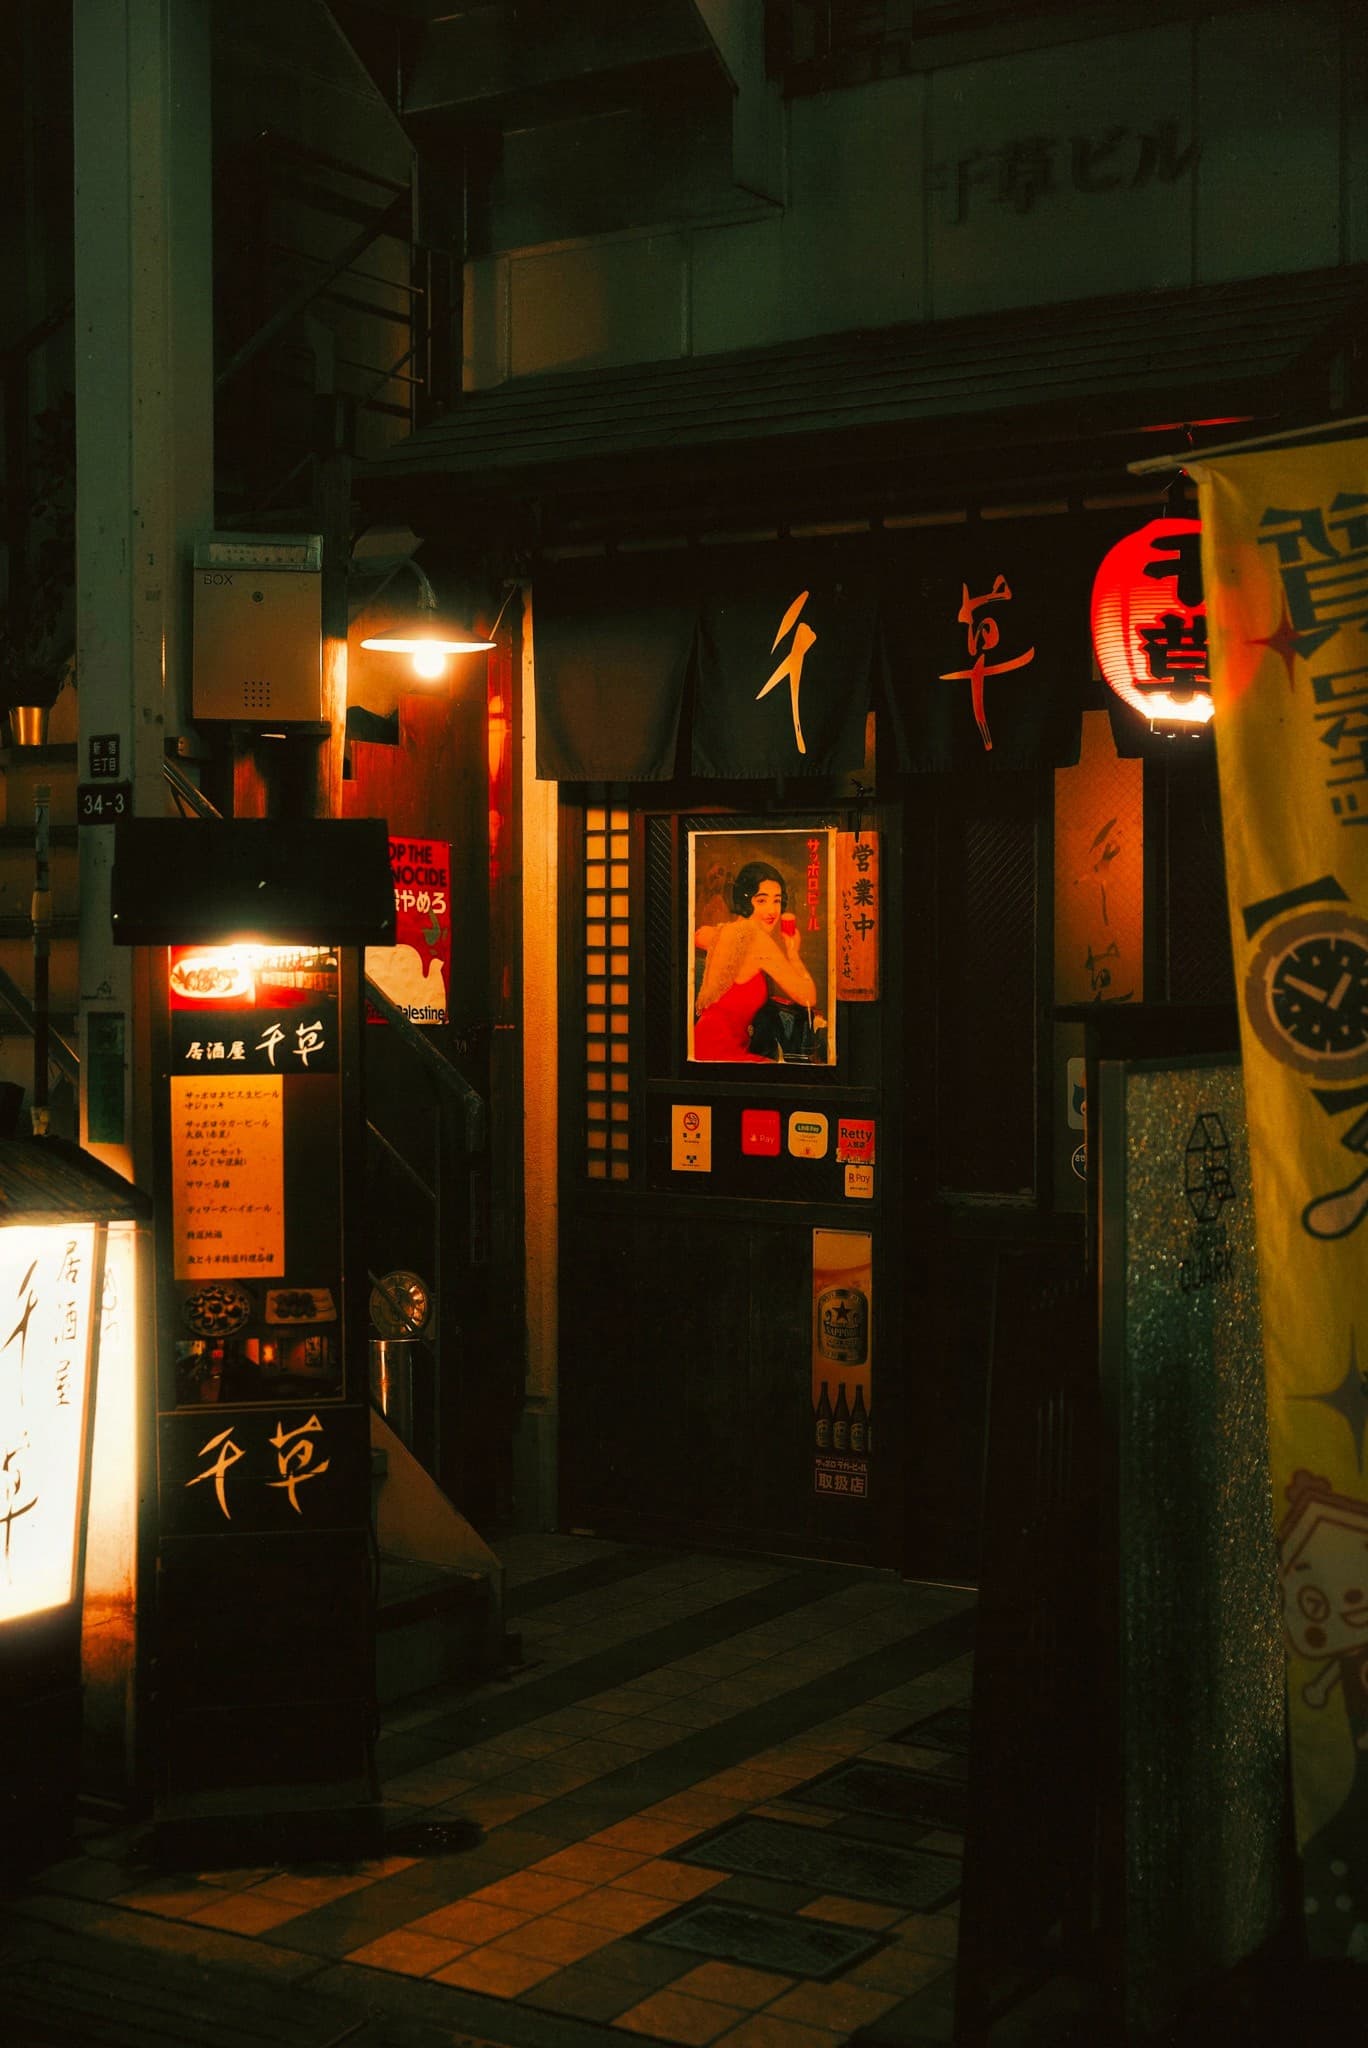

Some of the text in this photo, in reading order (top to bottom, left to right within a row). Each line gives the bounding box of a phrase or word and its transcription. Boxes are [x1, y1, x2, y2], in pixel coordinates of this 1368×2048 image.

[203, 574, 233, 585] BOX
[755, 571, 1036, 755] 千草
[83, 793, 126, 815] 34-3
[387, 844, 433, 864] OP THE
[392, 867, 448, 888] NOCIDE
[806, 838, 821, 932] サッポロビール
[851, 844, 876, 942] 営業中
[185, 1019, 325, 1067] 居酒屋 千草
[840, 1127, 873, 1143] Retty
[54, 1239, 81, 1407] 居酒屋
[184, 1412, 331, 1521] 千草
[818, 1472, 866, 1495] 取扱店
